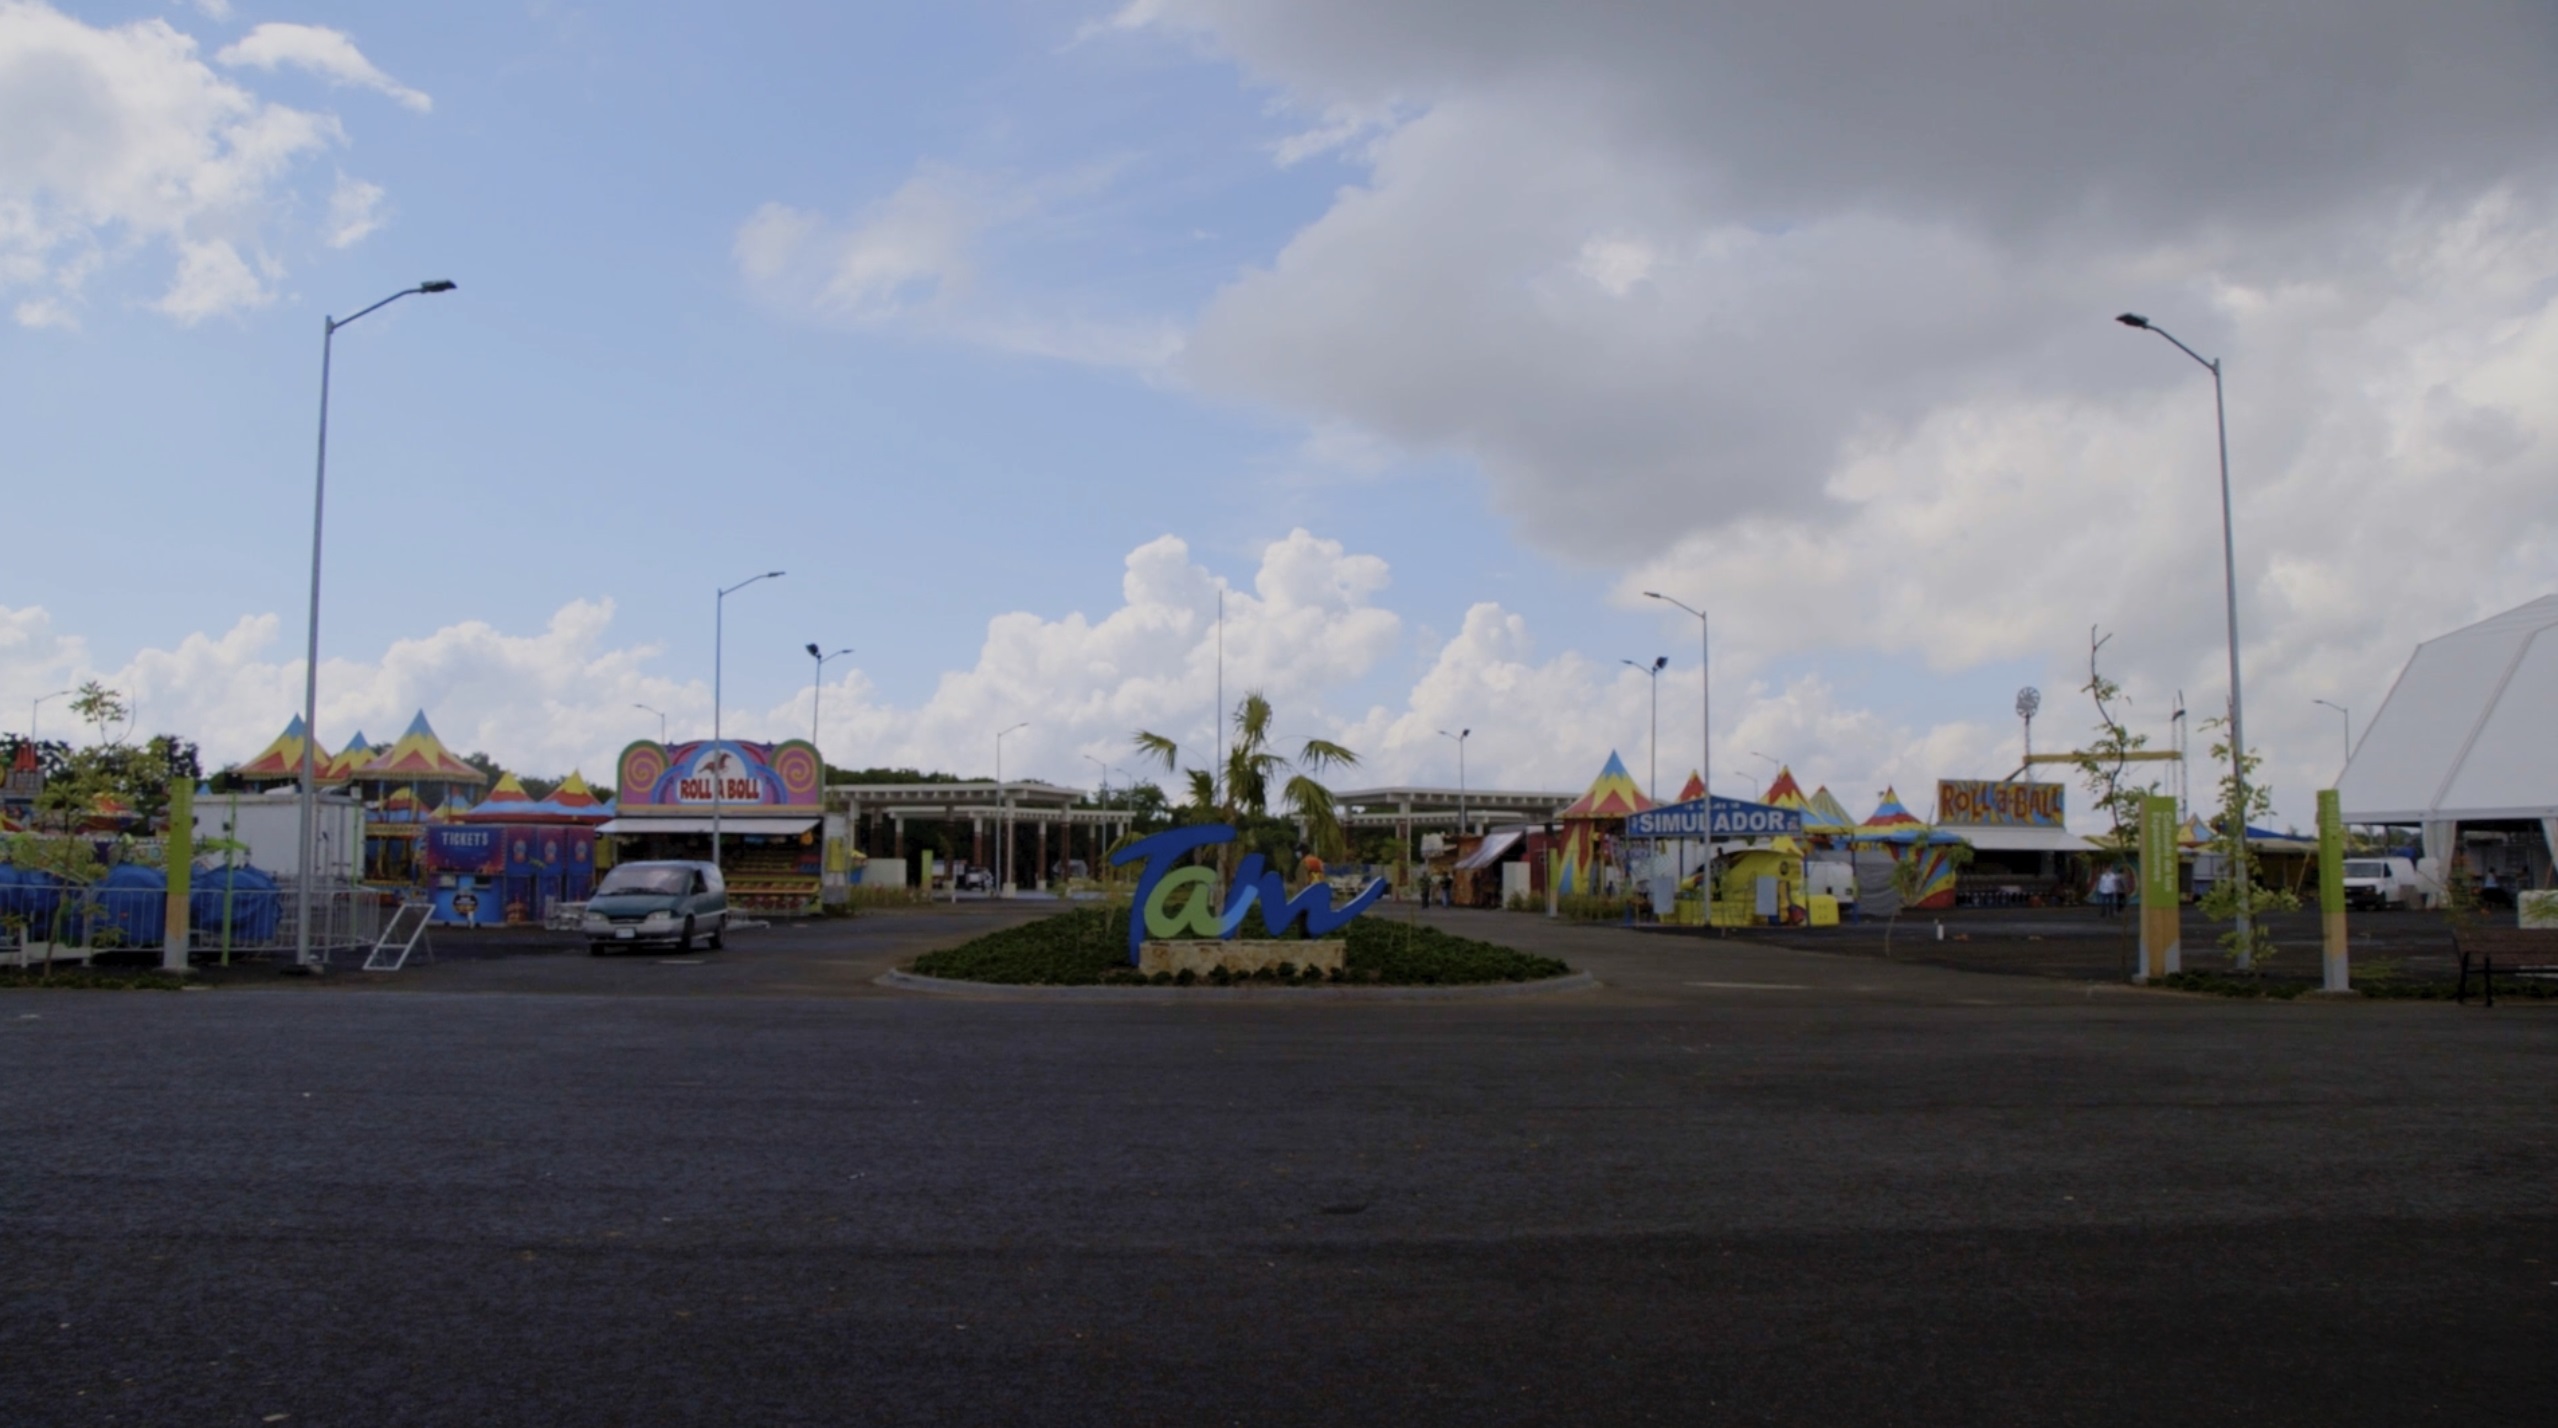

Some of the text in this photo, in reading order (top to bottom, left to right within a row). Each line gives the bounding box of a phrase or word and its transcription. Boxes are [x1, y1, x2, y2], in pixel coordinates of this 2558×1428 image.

[680, 779, 711, 799] ROLL
[728, 779, 760, 799] BOLL
[1640, 811, 1785, 833] SIMULADOR
[441, 832, 489, 846] TICKETS
